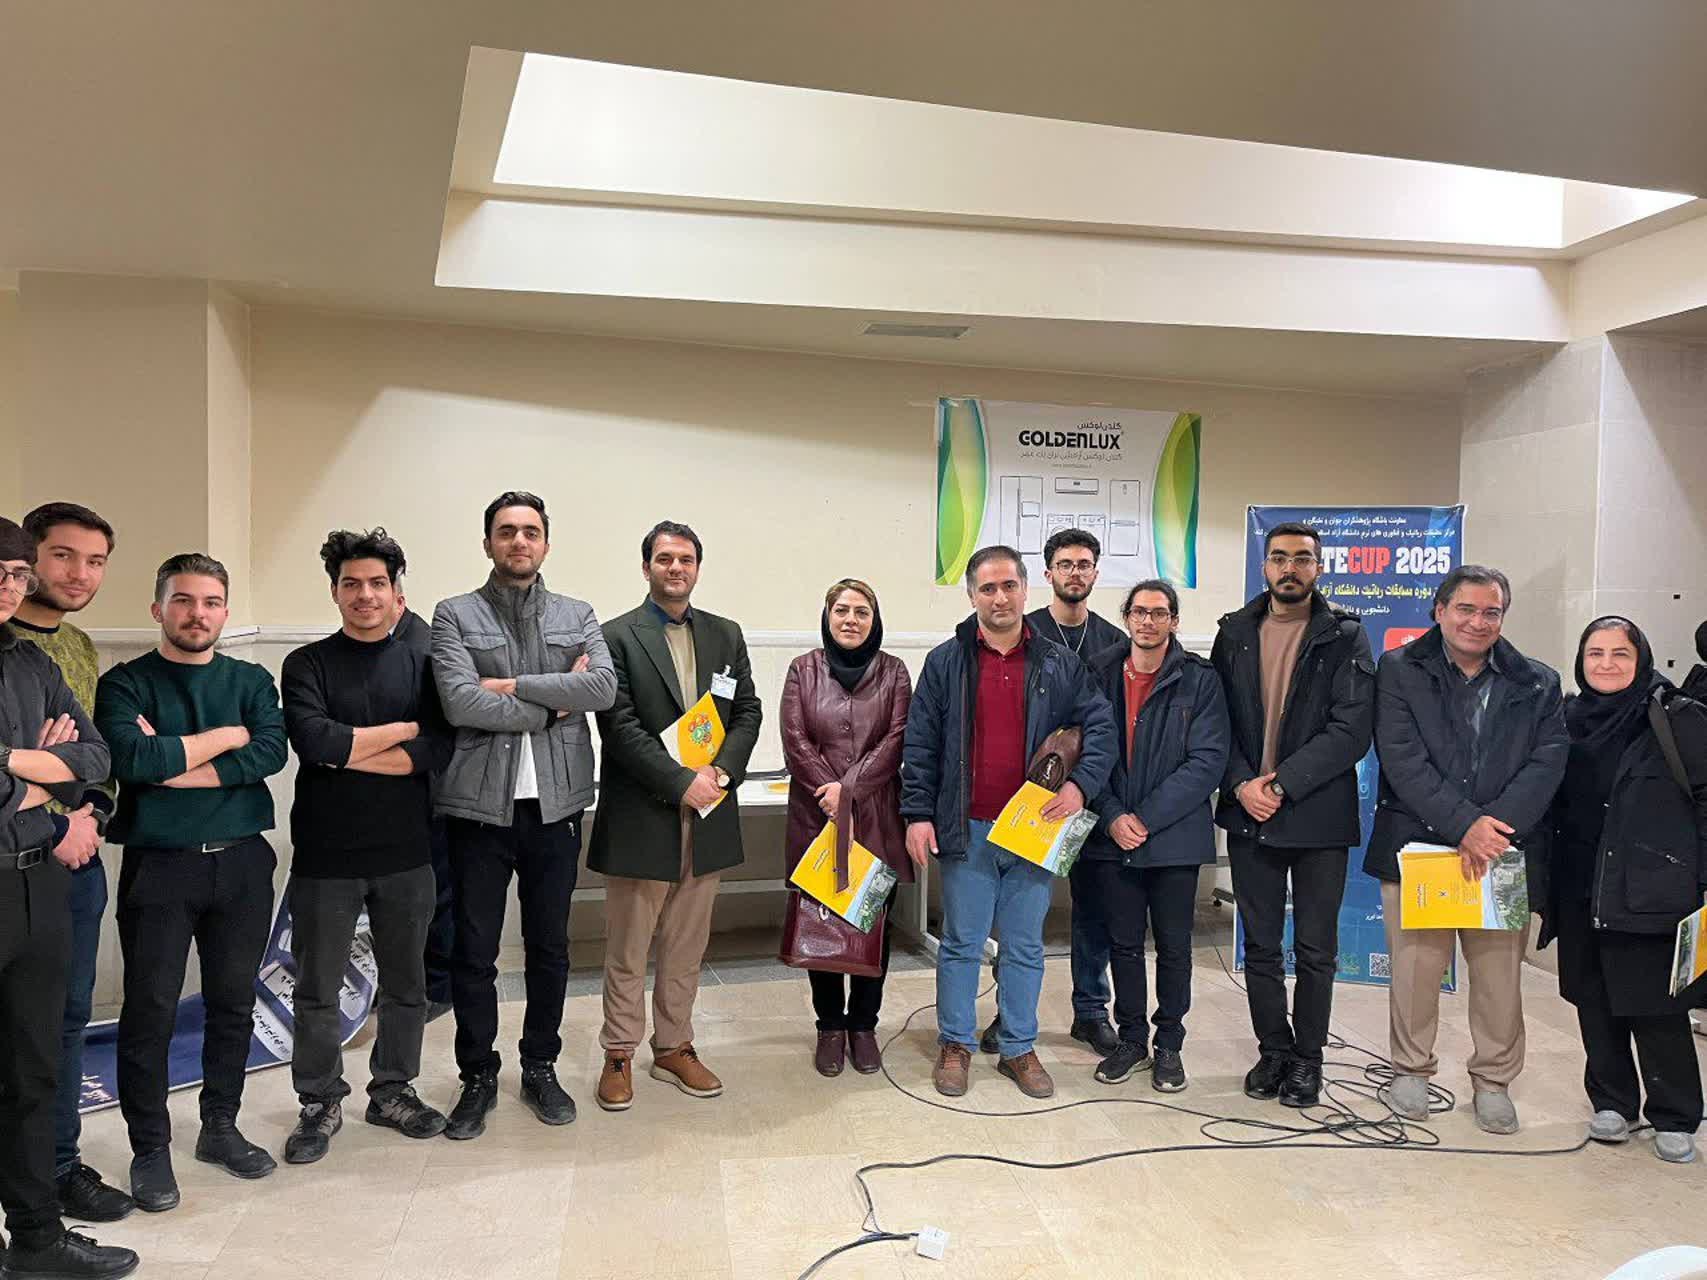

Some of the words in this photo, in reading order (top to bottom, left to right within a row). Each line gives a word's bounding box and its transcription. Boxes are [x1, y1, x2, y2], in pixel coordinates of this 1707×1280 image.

[1018, 430, 1121, 450] GOLDENLUX
[1328, 516, 1343, 525] جوان
[1342, 515, 1371, 527] پژوهشگران
[1371, 515, 1388, 526] باشگاه
[1331, 527, 1341, 538] آزاد
[1341, 528, 1360, 536] دانشگاه
[1360, 529, 1370, 540] نرم
[1370, 528, 1382, 538] های
[1405, 528, 1423, 538] رباتیک
[1423, 528, 1443, 538] تحقیقات
[1444, 528, 1456, 537] مرکز
[1320, 546, 1390, 575] TECUP
[1395, 546, 1450, 575] 2025
[1334, 583, 1360, 596] دانشگاه
[1361, 583, 1384, 600] رباتیک
[1384, 584, 1413, 599] مسابقات
[1414, 587, 1432, 599] دوره
[1354, 607, 1361, 616] و
[1361, 604, 1391, 617] دانشجویی
